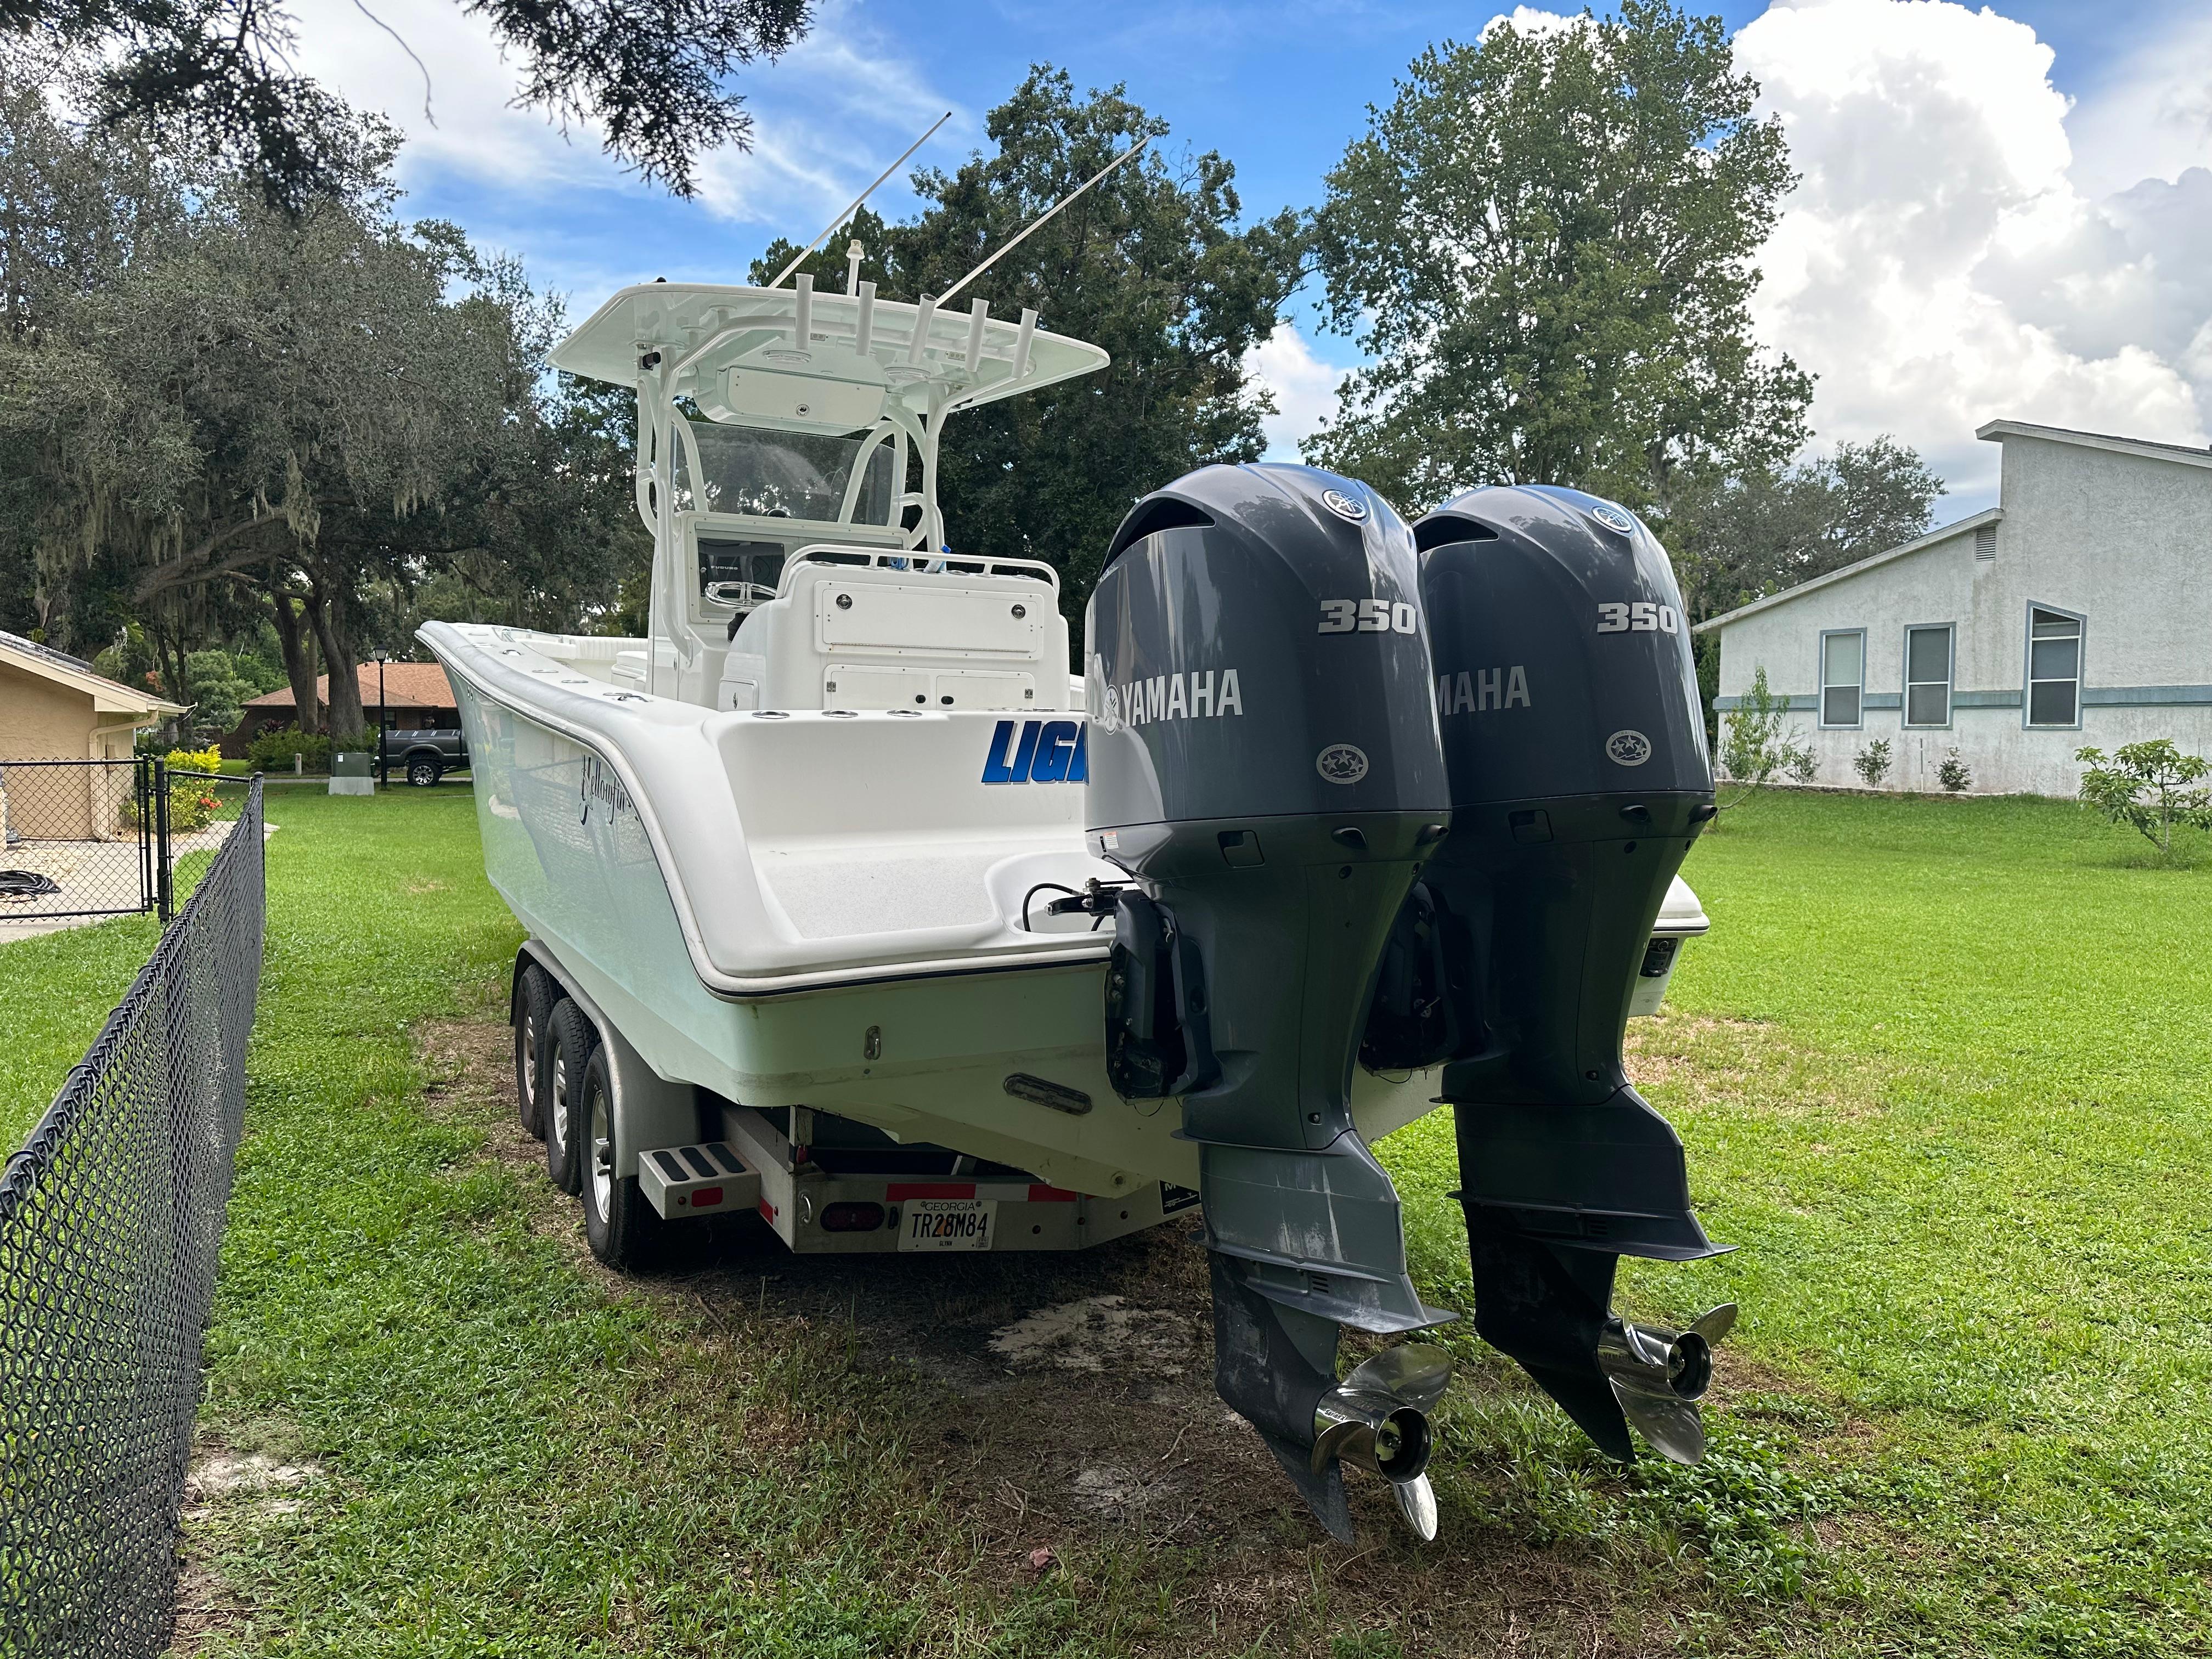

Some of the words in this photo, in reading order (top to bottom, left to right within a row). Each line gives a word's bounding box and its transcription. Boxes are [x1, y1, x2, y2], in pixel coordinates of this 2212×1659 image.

[1318, 599, 1416, 635] 350
[1597, 602, 1678, 634] 350
[1121, 669, 1243, 727] YAMAHA
[924, 1202, 975, 1211] GEORGIA
[912, 1212, 988, 1238] TR28M84
